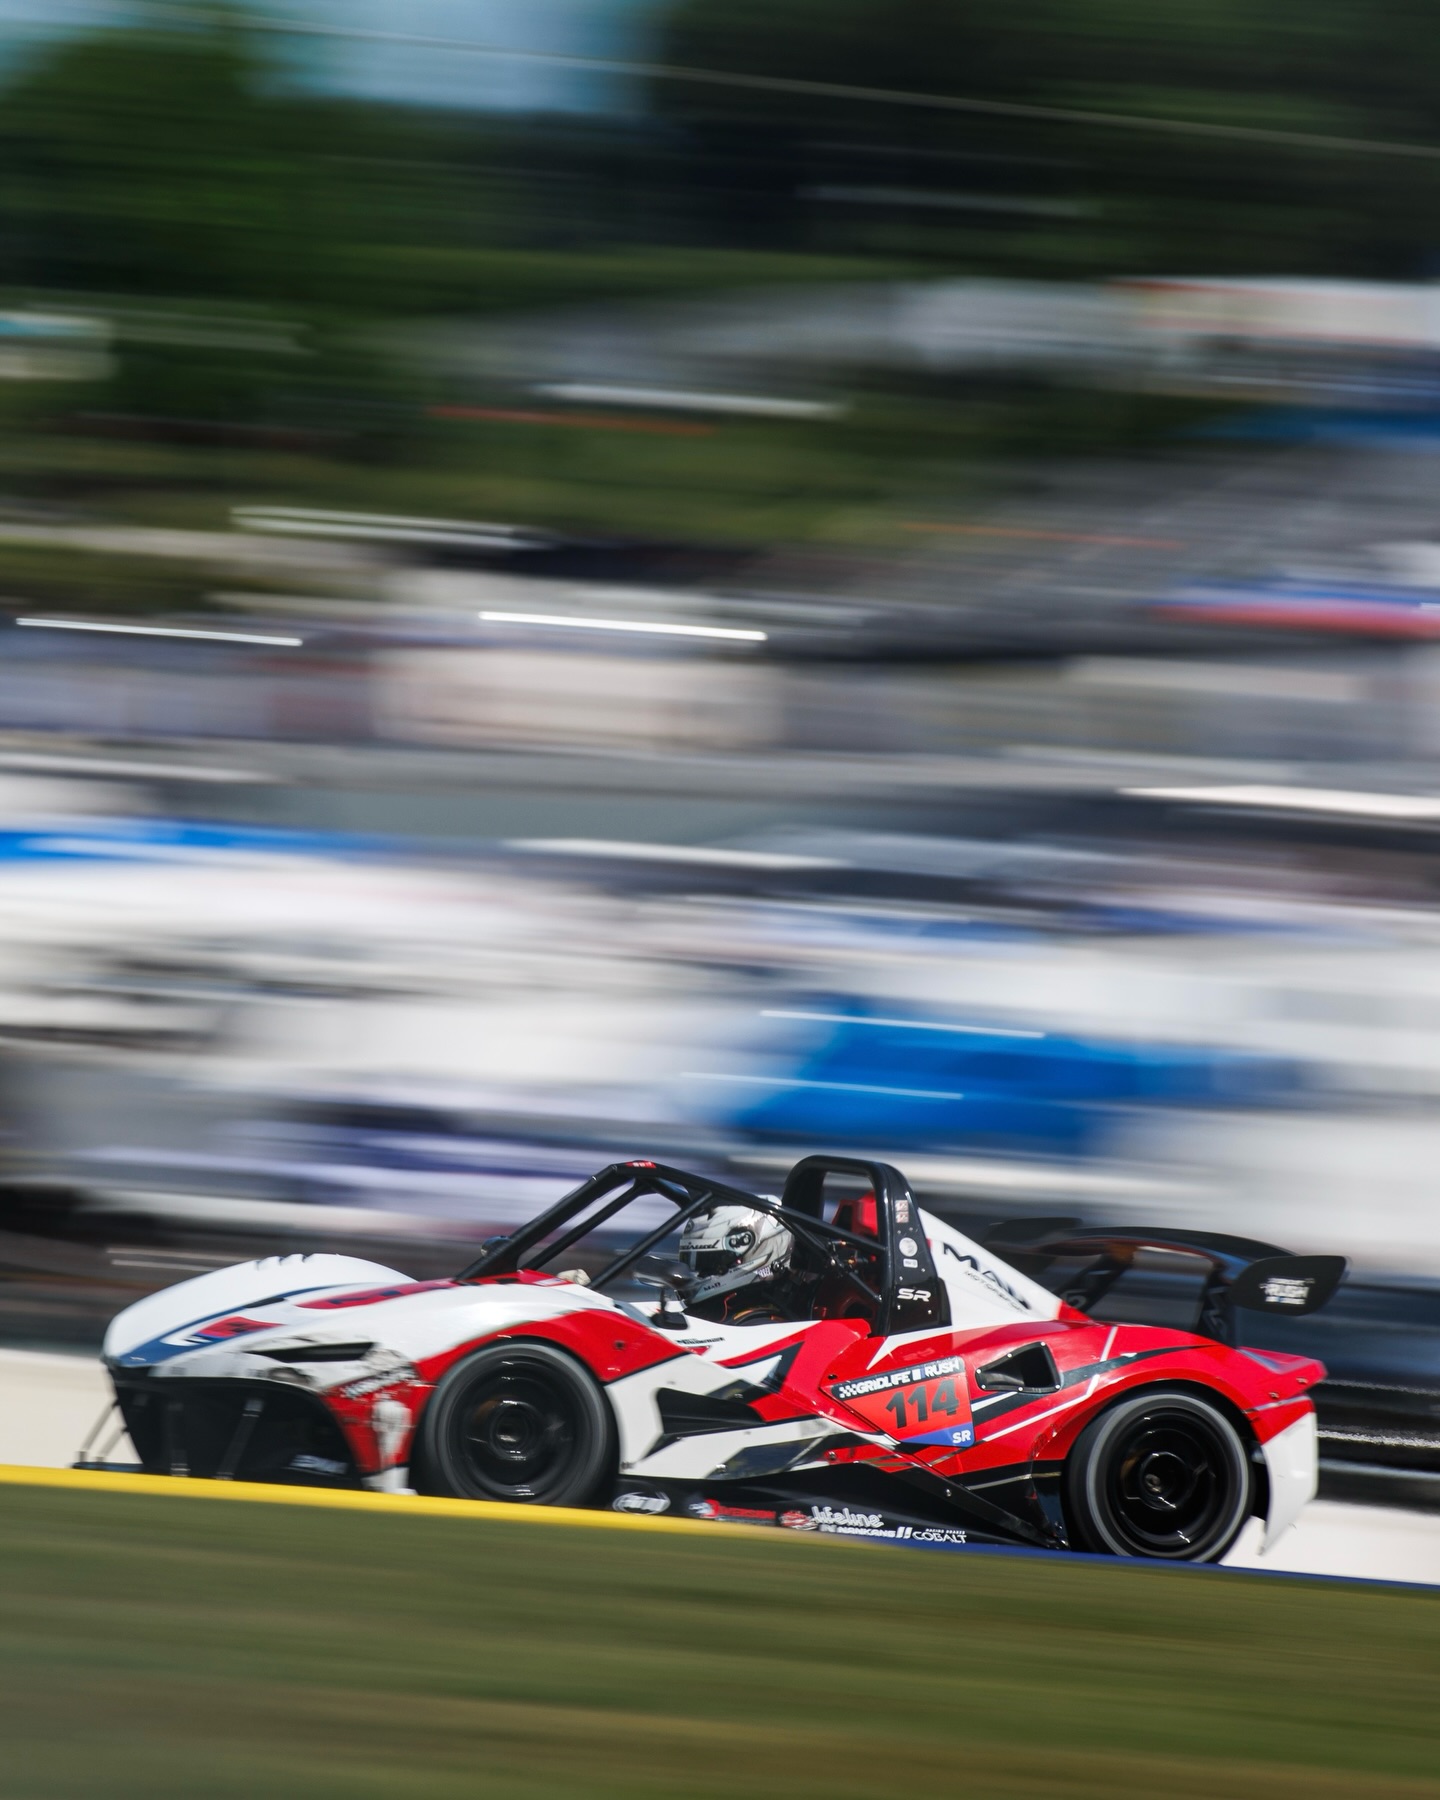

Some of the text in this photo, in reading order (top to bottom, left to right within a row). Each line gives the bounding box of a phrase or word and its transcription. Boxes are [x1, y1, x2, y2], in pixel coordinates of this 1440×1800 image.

[897, 1288, 931, 1302] SR
[856, 1359, 960, 1395] GRIDLIFE RUSH
[886, 1378, 960, 1429] 114
[952, 1429, 971, 1444] SR
[912, 1531, 967, 1544] COBALT
